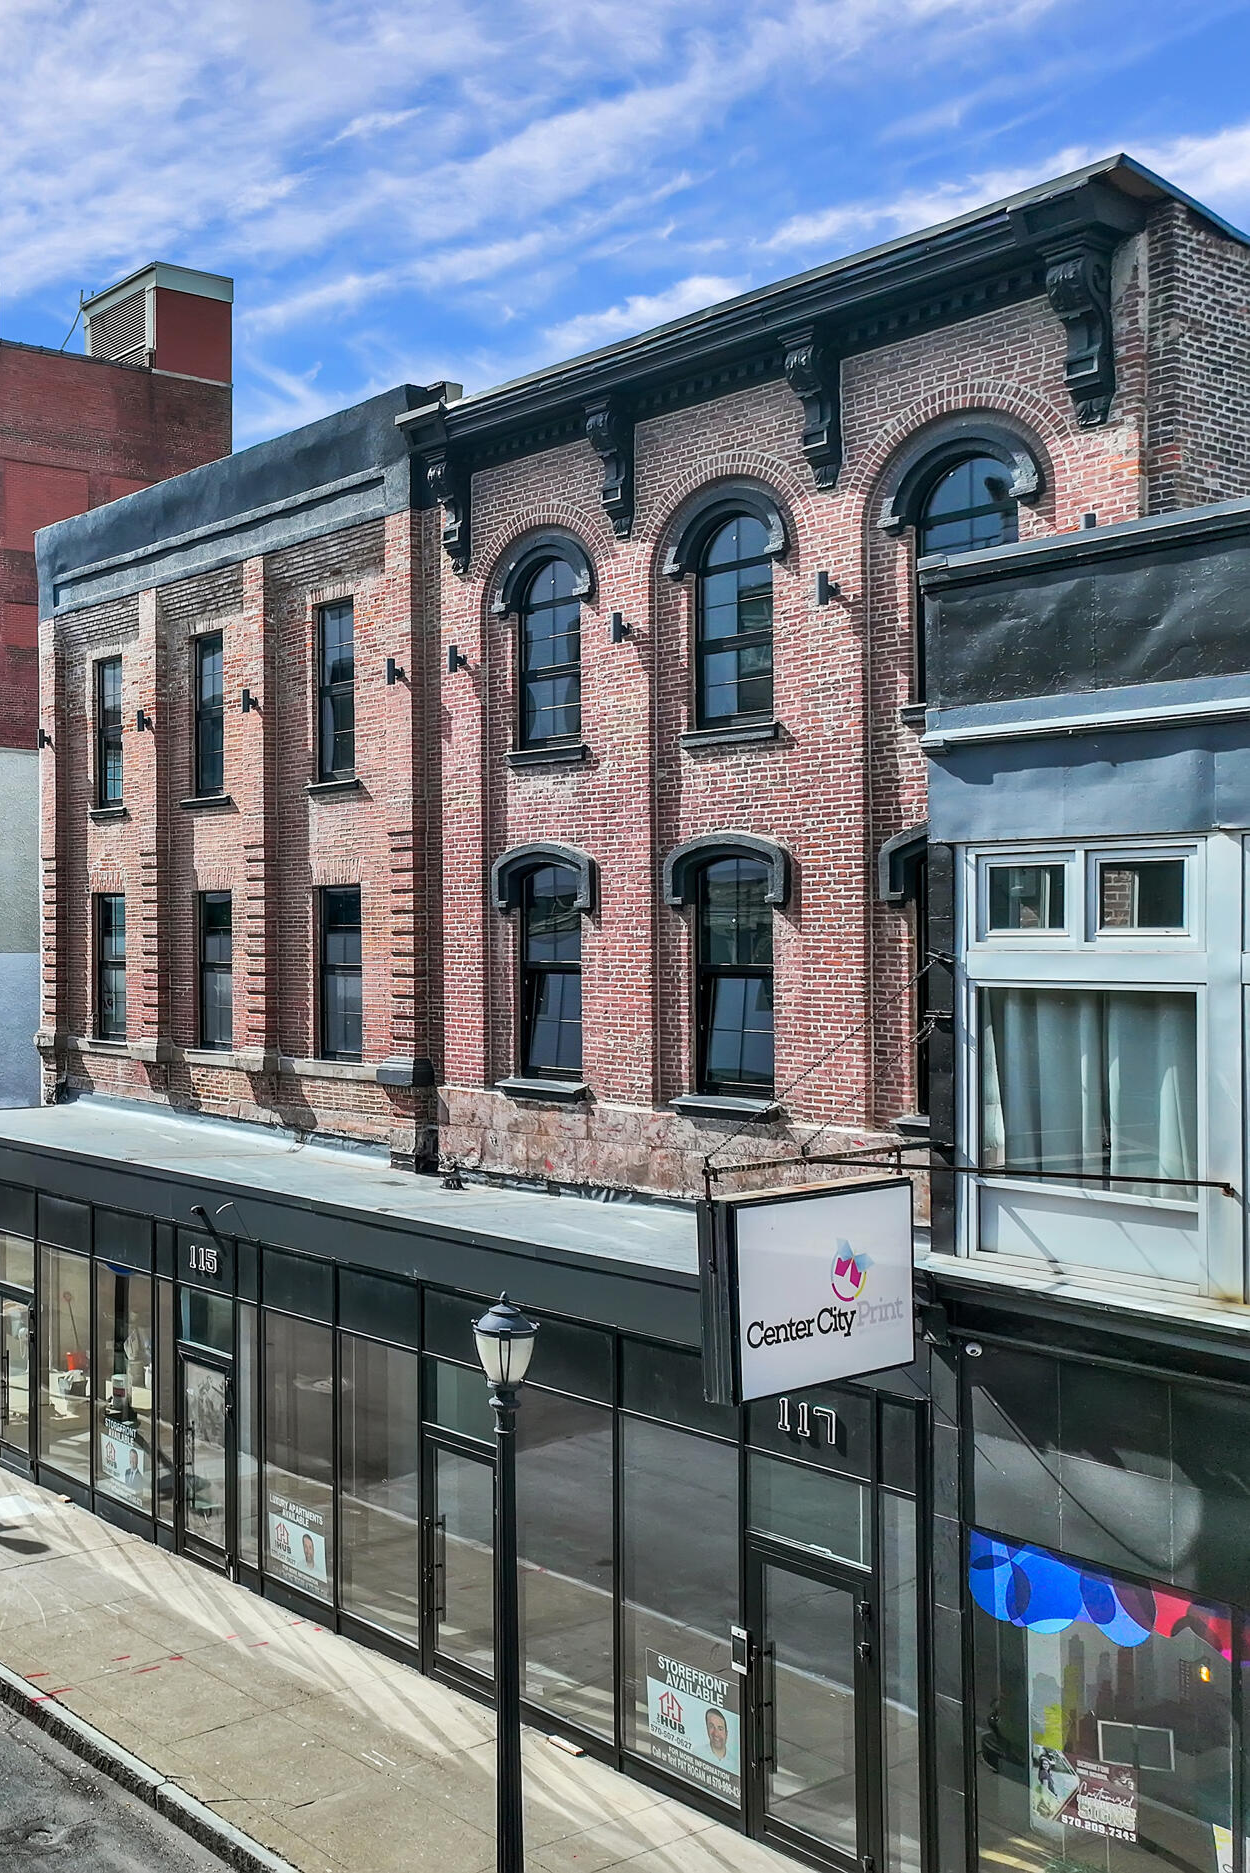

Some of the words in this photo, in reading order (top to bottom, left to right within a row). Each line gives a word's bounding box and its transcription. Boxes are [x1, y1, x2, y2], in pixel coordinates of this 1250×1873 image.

[189, 1245, 217, 1274] 115
[747, 1317, 815, 1349] Center
[816, 1306, 857, 1338] City
[857, 1297, 904, 1327] Print
[104, 1417, 137, 1439] STOREFRONT
[777, 1397, 836, 1445] 117
[269, 1493, 289, 1511] LUXURY
[288, 1502, 324, 1526] APARTMENTS
[282, 1508, 310, 1528] AVAILABLE
[657, 1655, 729, 1696] STOREFRONT
[665, 1672, 724, 1708] AVAILABLE
[660, 1714, 686, 1735] HUB
[1061, 1813, 1137, 1843] 570.209.7343
